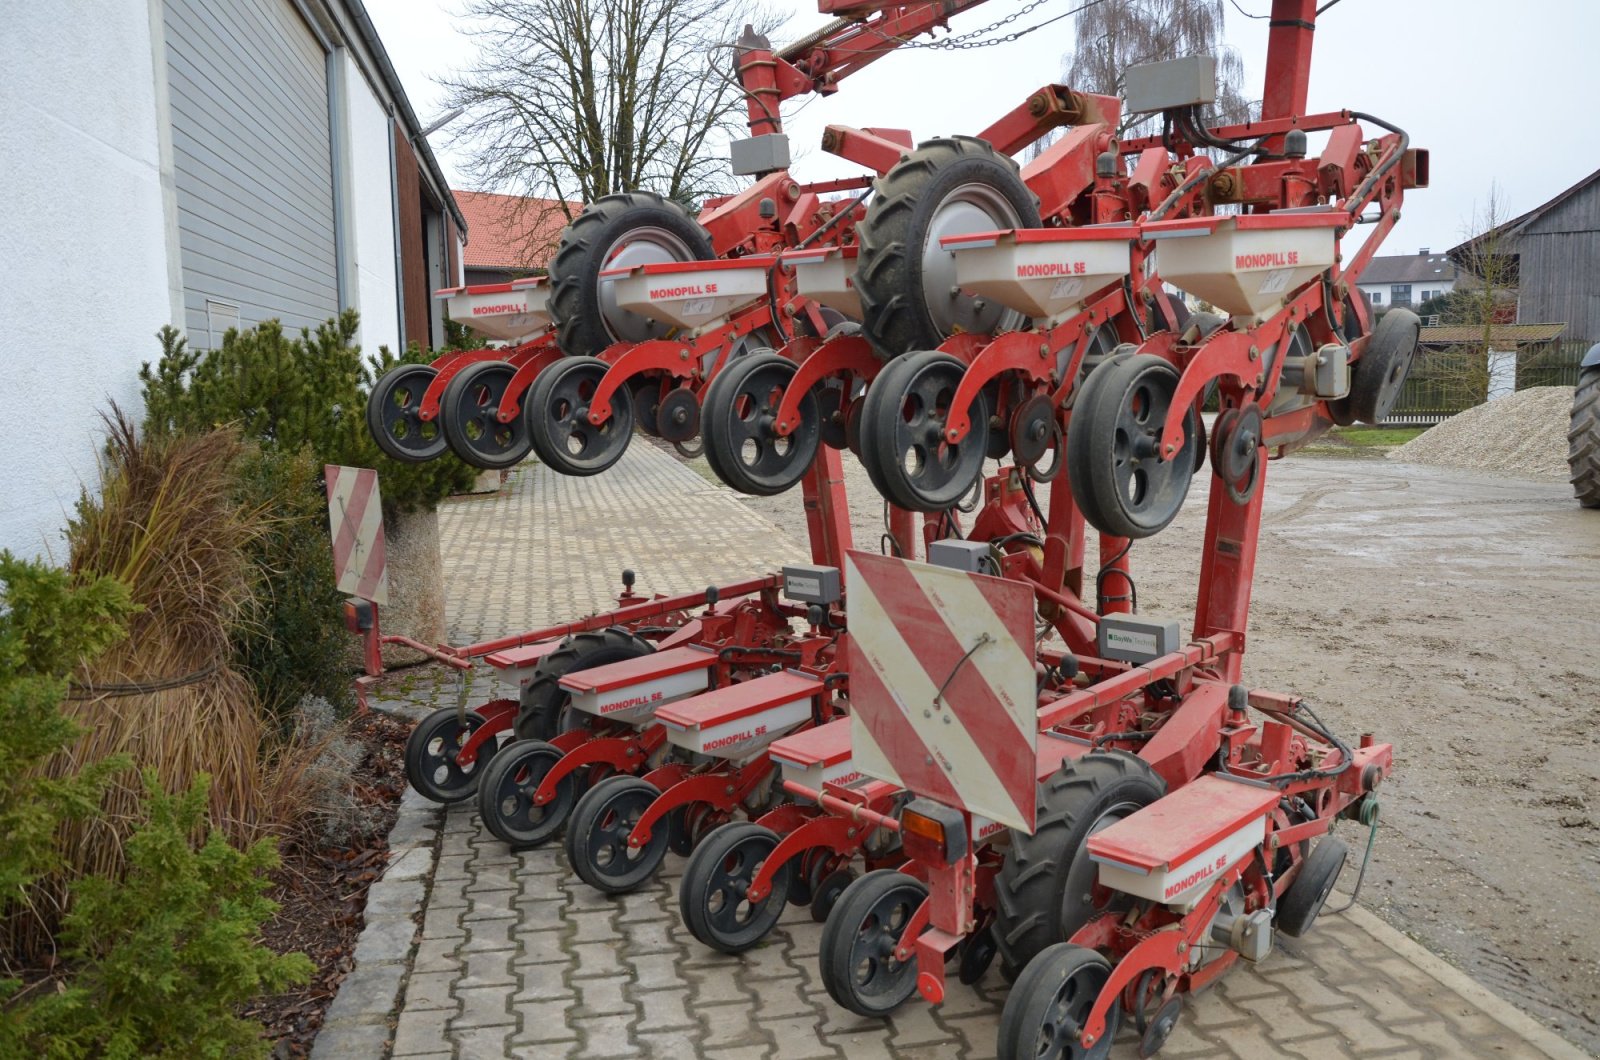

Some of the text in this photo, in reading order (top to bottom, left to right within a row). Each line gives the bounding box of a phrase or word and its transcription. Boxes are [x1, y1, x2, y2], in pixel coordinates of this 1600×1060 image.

[1235, 251, 1298, 269] MONOPILL SE
[1017, 262, 1086, 277] MONOPILL SE
[650, 283, 718, 299] MONOPILL SE
[473, 303, 521, 315] MONOPILL
[600, 691, 663, 714] MONOPILL SE
[703, 724, 767, 752] MONOPILL SE
[1165, 854, 1227, 899] MONOPILL SE
